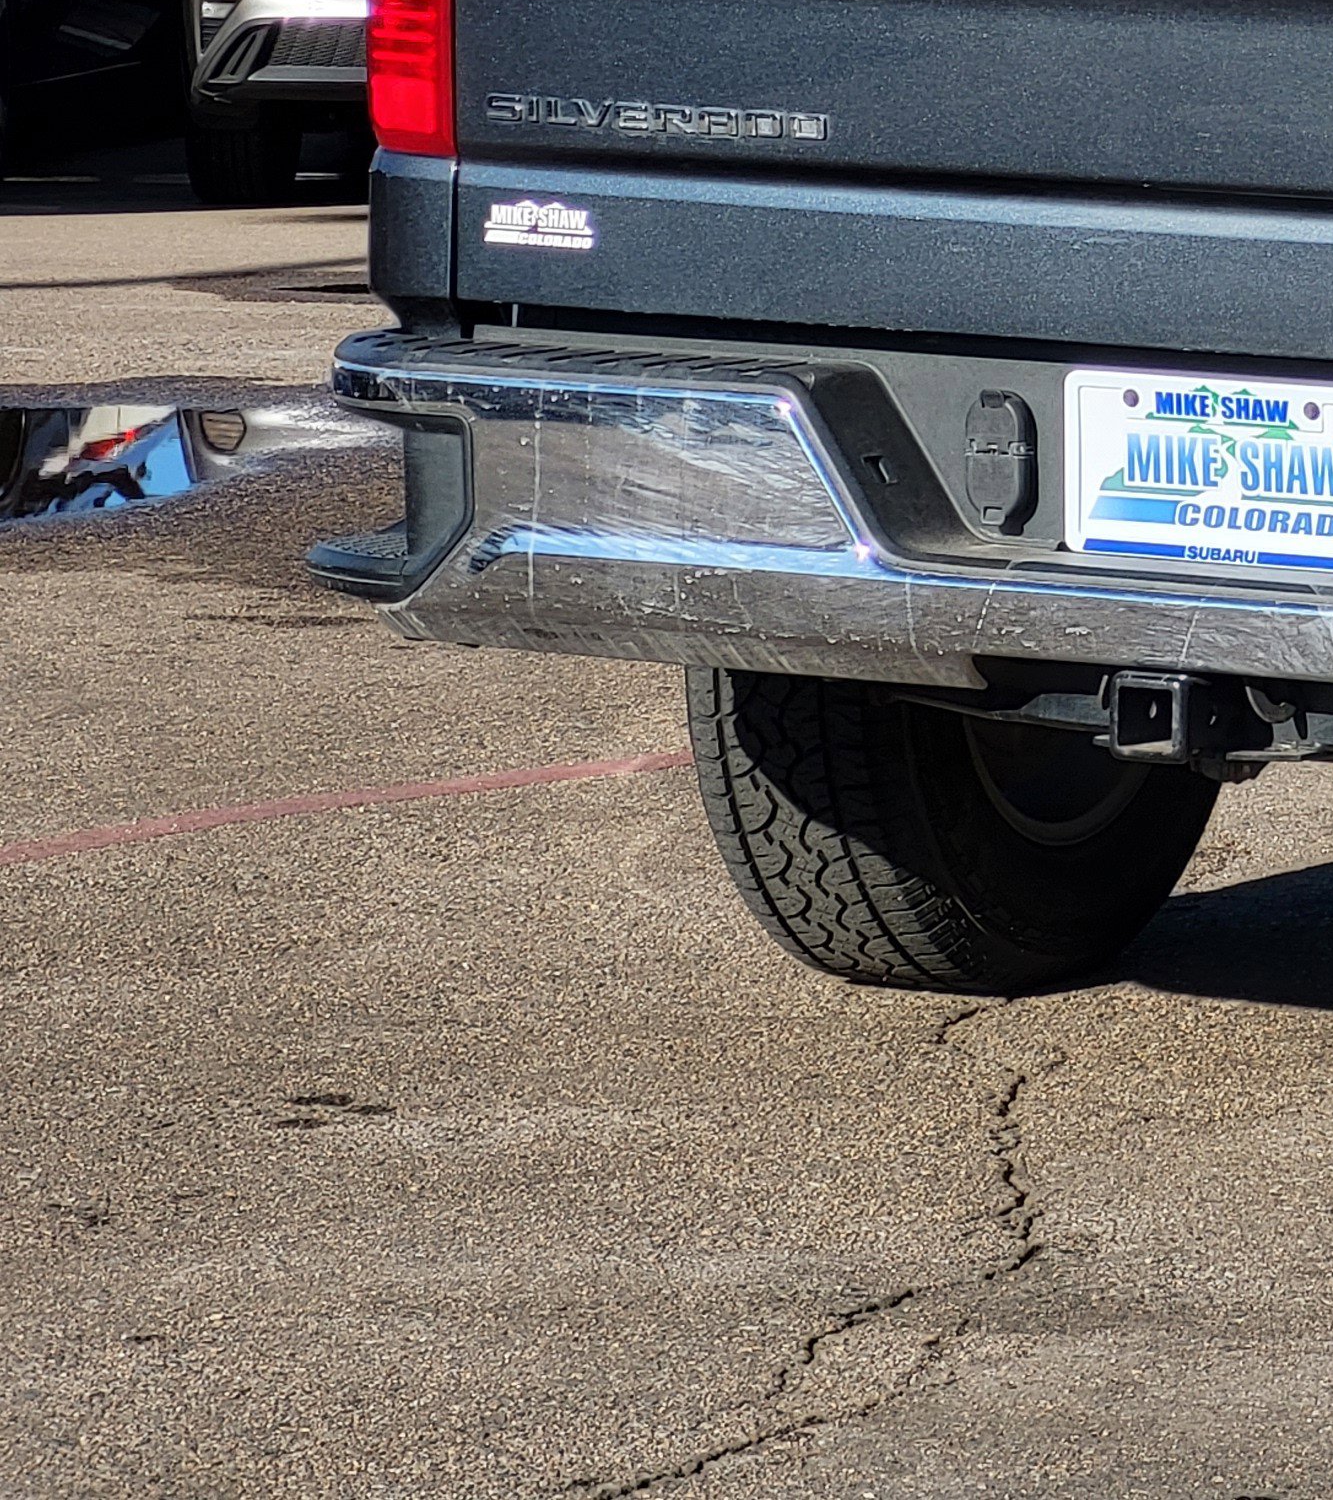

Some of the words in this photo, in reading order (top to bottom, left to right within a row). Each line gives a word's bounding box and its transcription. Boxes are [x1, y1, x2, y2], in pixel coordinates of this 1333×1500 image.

[486, 92, 830, 141] SILVERADO
[491, 204, 534, 227] MIKE
[538, 207, 588, 230] SHAW
[519, 232, 593, 249] COLORADO
[1155, 391, 1211, 417] MIKE
[1221, 397, 1289, 423] SHAW
[1127, 433, 1219, 488] MIKE
[1186, 544, 1258, 564] SUBARU
